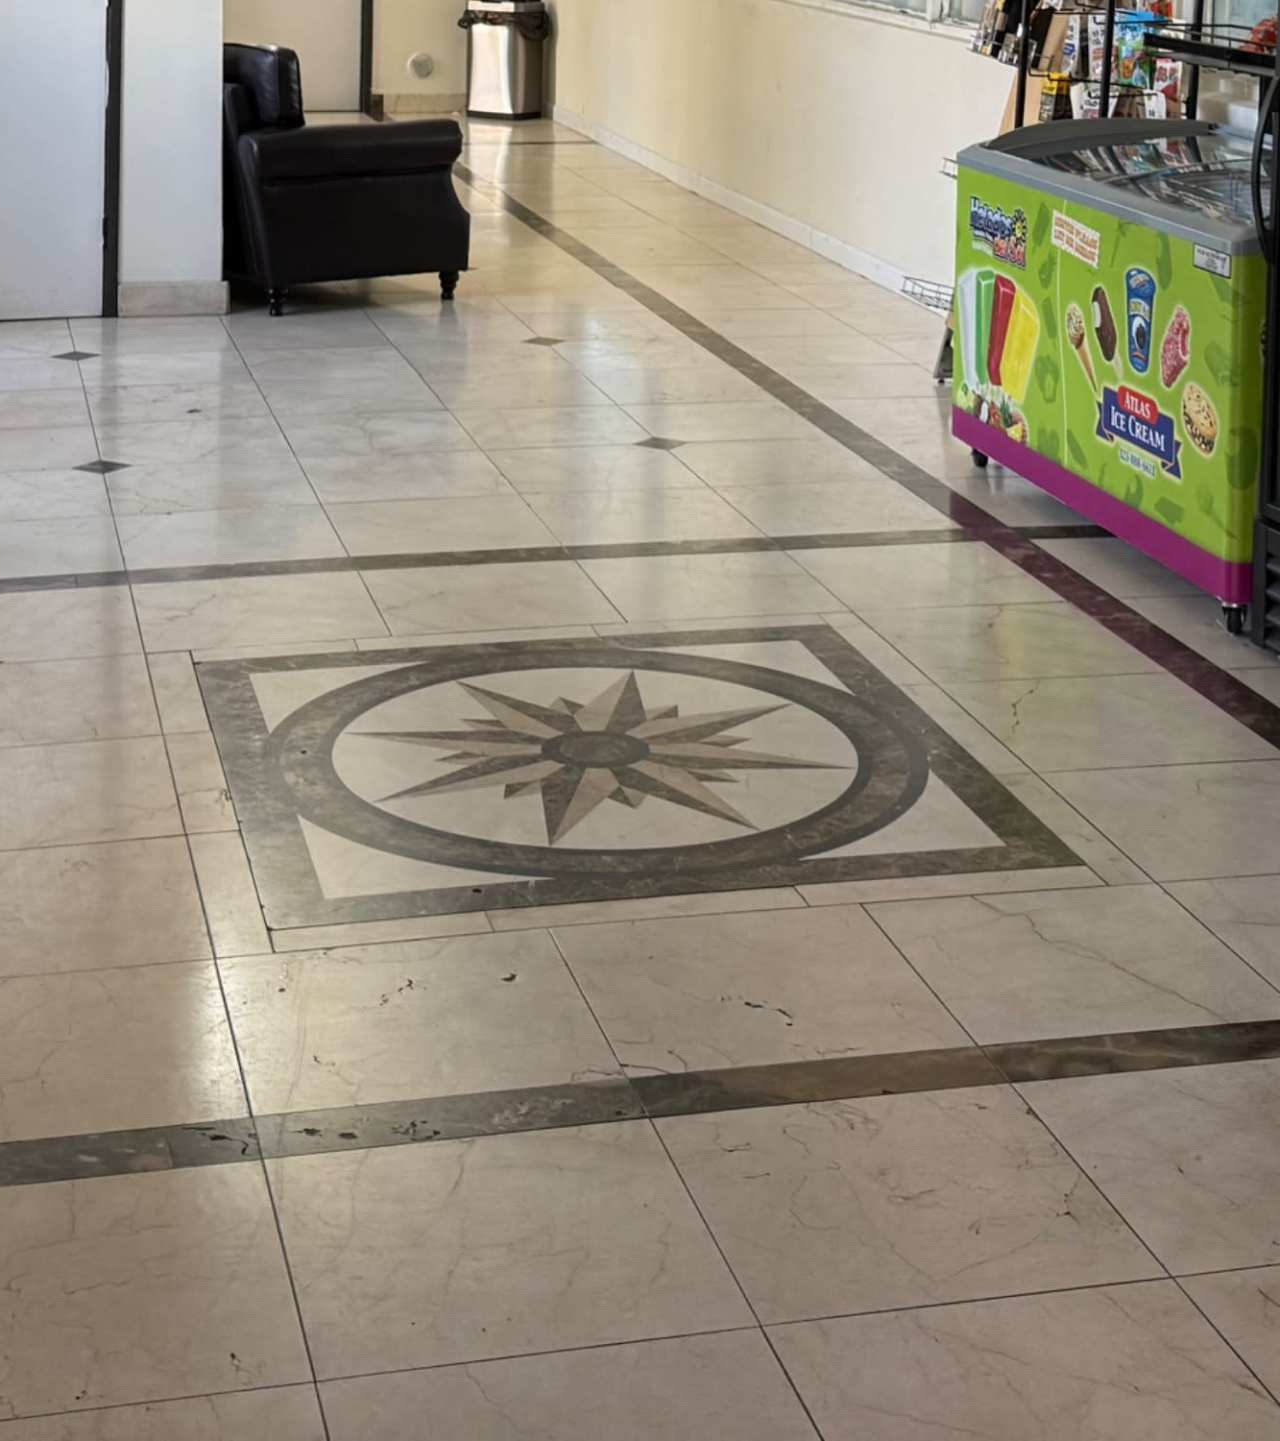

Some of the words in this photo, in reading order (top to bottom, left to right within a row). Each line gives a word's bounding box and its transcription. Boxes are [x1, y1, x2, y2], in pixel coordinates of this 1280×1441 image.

[1123, 391, 1152, 419] ATLAS
[1110, 406, 1126, 432] ICE
[1128, 415, 1166, 453] CREAM
